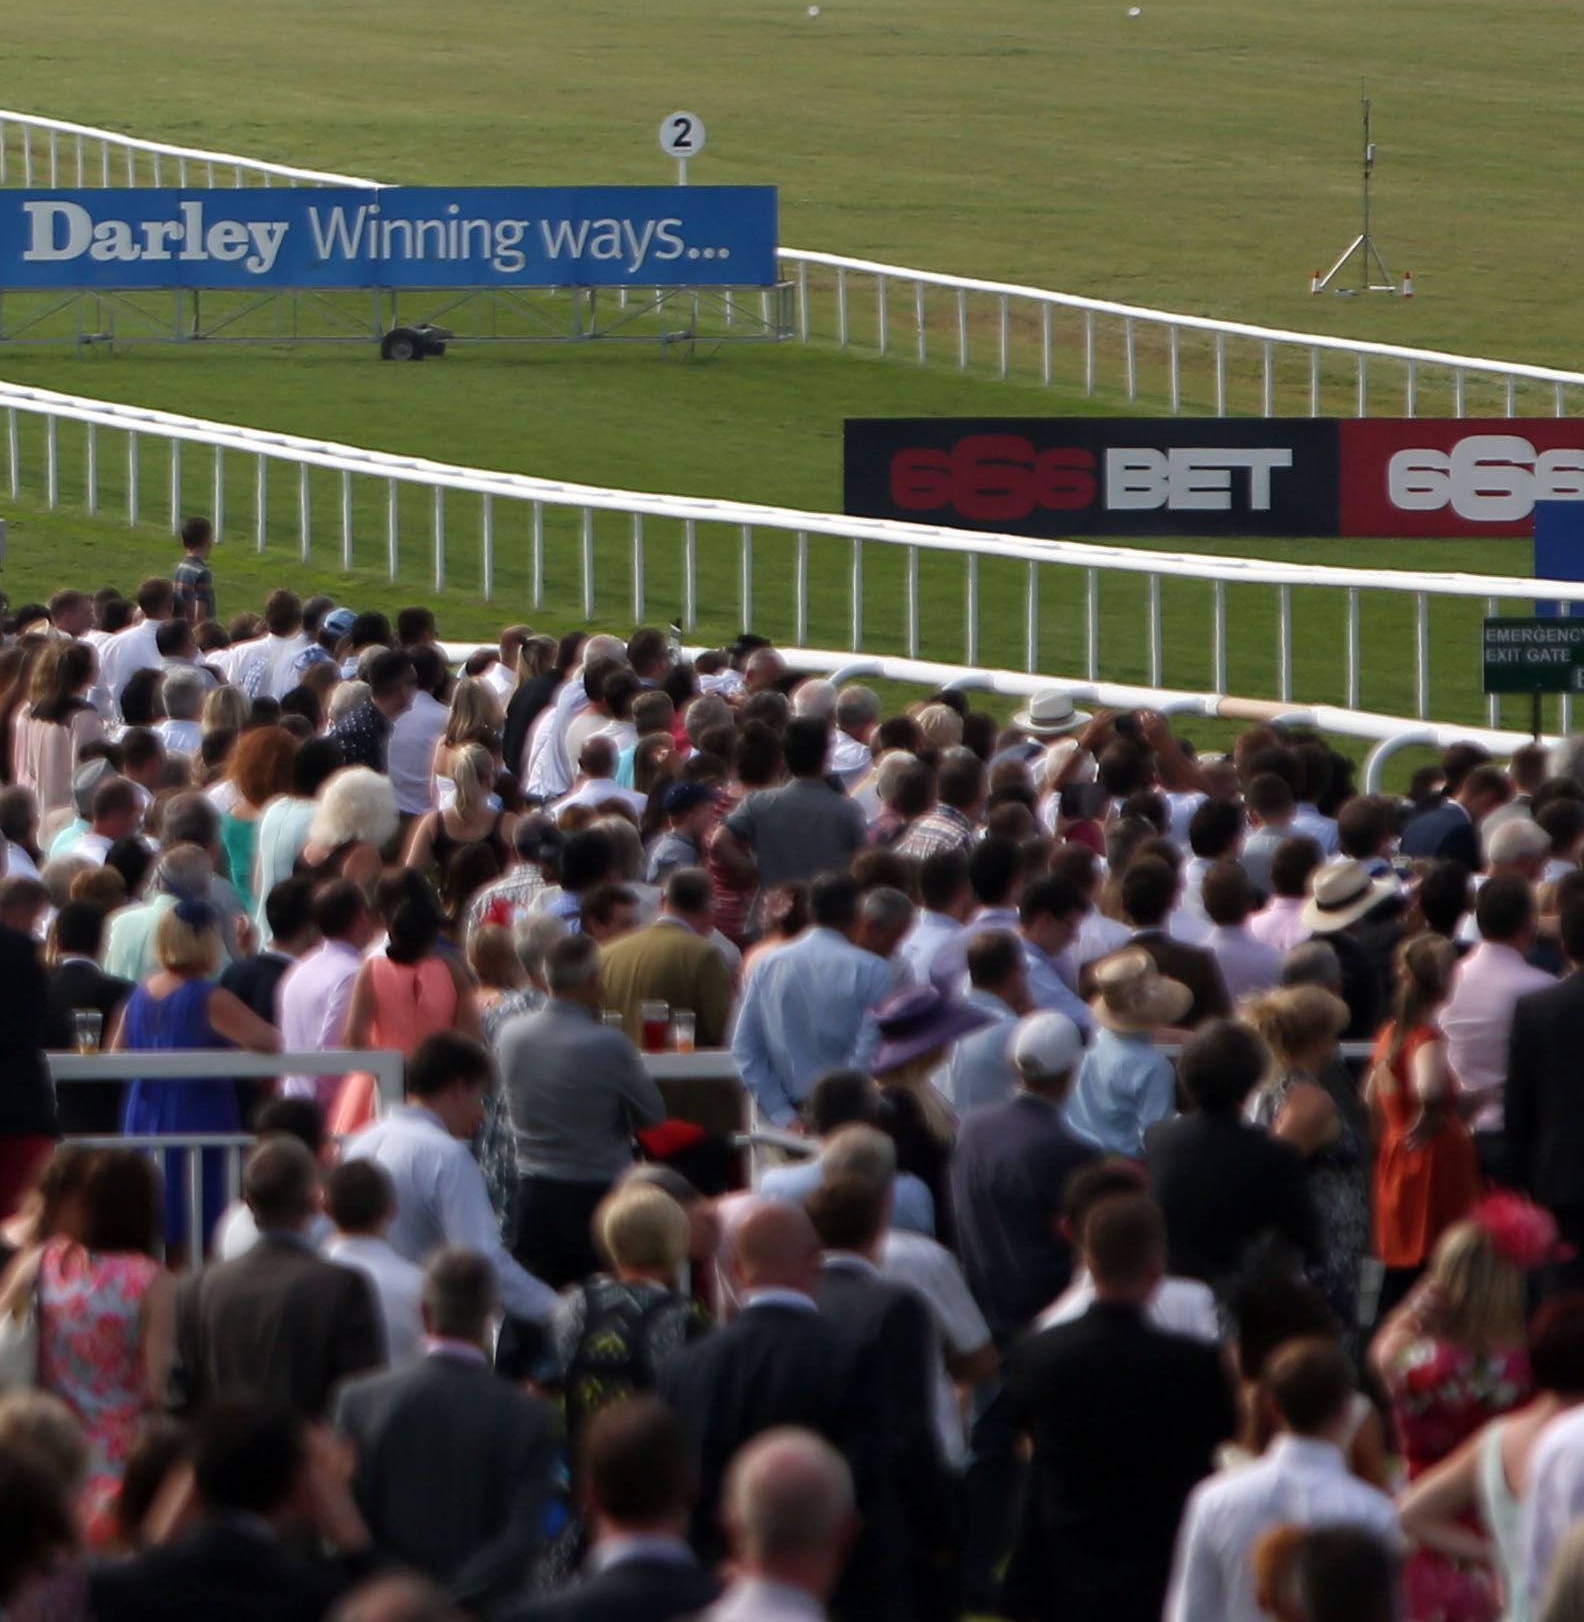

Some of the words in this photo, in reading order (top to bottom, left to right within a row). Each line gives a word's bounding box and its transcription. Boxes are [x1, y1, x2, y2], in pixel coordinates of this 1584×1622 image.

[673, 118, 692, 147] 2
[22, 200, 290, 274] Darley
[308, 203, 529, 273] Winning
[541, 216, 731, 274] ways...
[1486, 629, 1584, 642] EMERGENC
[1486, 649, 1520, 662] EXIT
[1527, 649, 1571, 662] GATE
